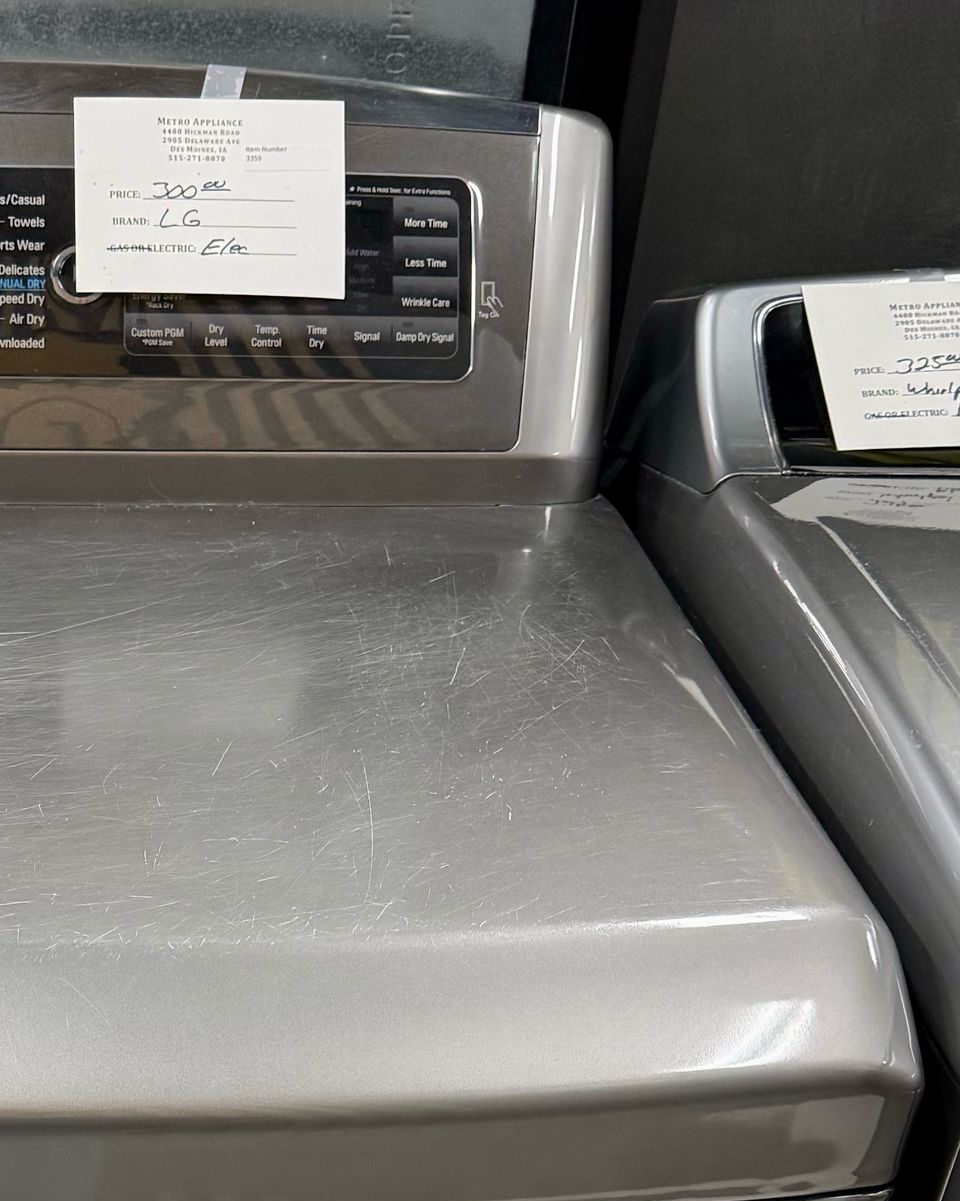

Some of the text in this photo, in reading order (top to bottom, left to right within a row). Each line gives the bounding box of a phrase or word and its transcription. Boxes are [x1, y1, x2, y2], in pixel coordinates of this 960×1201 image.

[193, 118, 243, 126] APPLIANCE
[110, 190, 140, 198] PRICE:
[426, 188, 451, 196] Functions
[8, 216, 45, 228] Towels
[112, 208, 200, 228] BRAND: LG
[404, 218, 448, 229] More Time
[17, 240, 45, 250] Wear
[405, 258, 447, 268] Less Time
[28, 279, 46, 289] DRY
[27, 294, 45, 306] Dry
[402, 297, 450, 307] Wrinkle Care
[10, 313, 45, 326] Air Dry
[478, 311, 488, 319] Tag
[131, 328, 184, 338] Custom PGM
[209, 324, 224, 336] Dry
[255, 325, 280, 336] Temp.
[307, 326, 327, 335] Time
[205, 337, 228, 347] Level
[251, 338, 282, 347] Control
[354, 332, 380, 343] Signal
[396, 332, 454, 344] Damp Dry Signal
[308, 338, 324, 350] Dry
[854, 366, 885, 375] PRICE:
[862, 389, 899, 398] BRAND:
